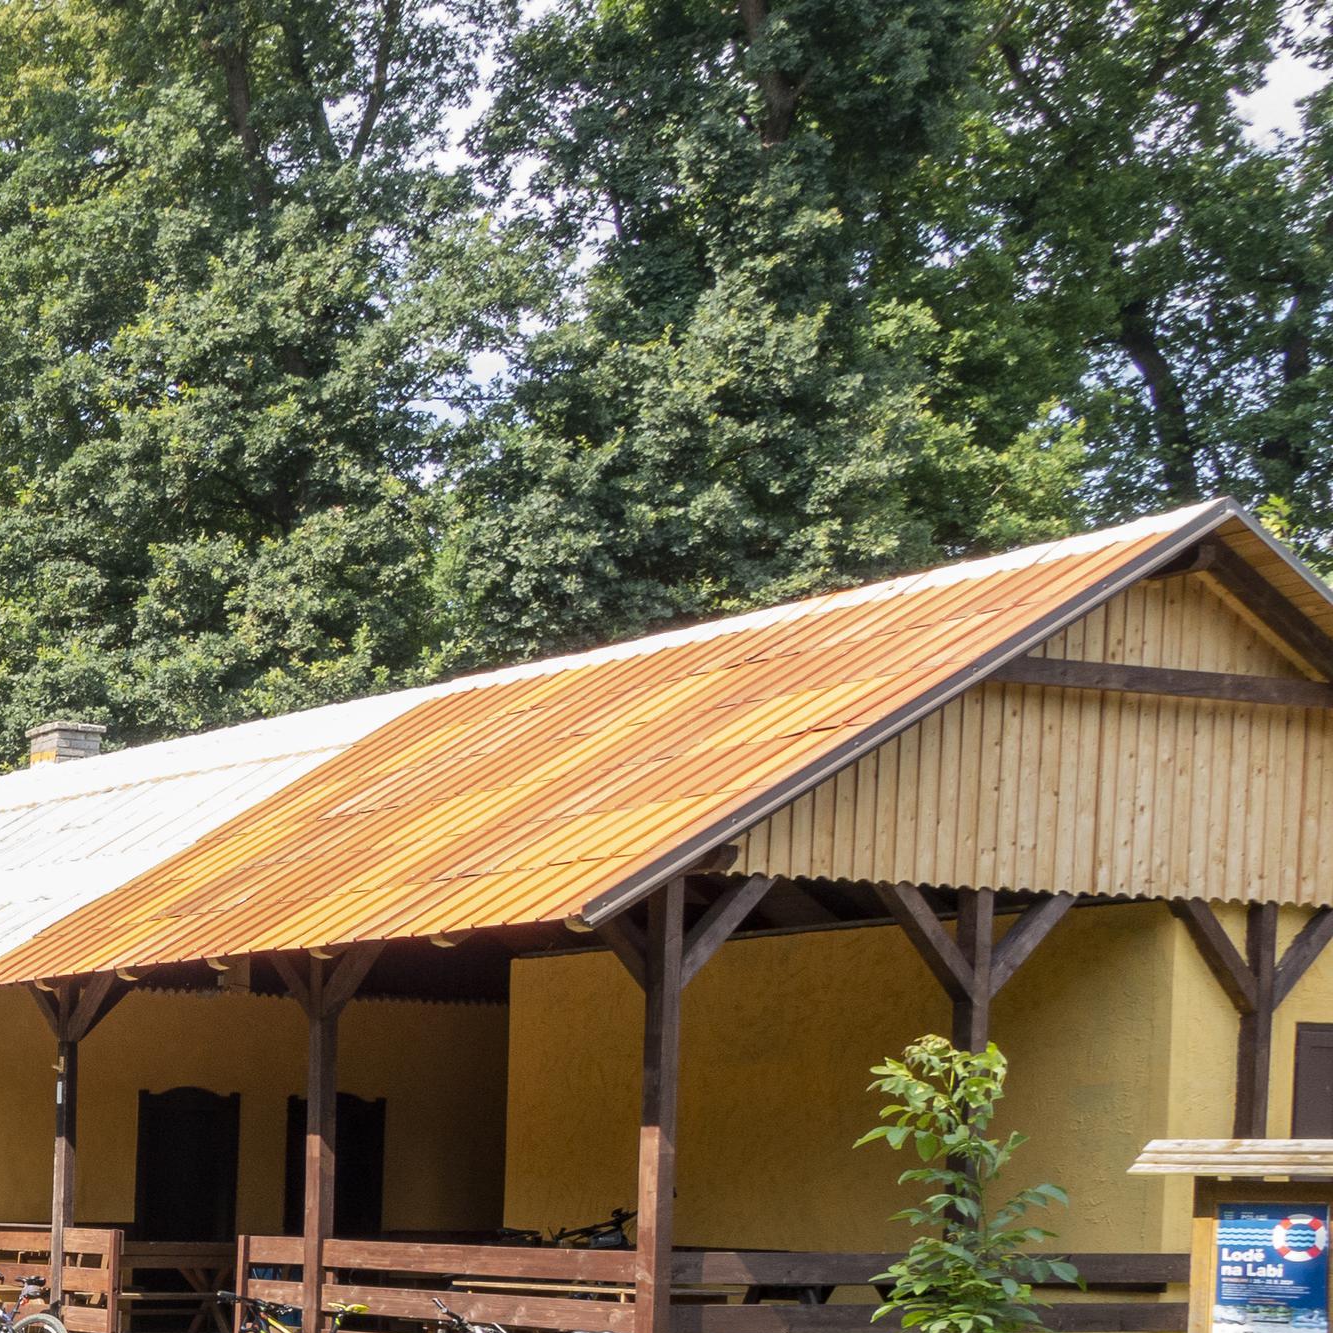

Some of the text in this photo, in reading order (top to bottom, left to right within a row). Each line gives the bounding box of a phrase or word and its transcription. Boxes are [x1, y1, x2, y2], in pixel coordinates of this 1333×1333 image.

[1221, 1248, 1265, 1262] Lodě
[1220, 1263, 1284, 1278] na Labi
